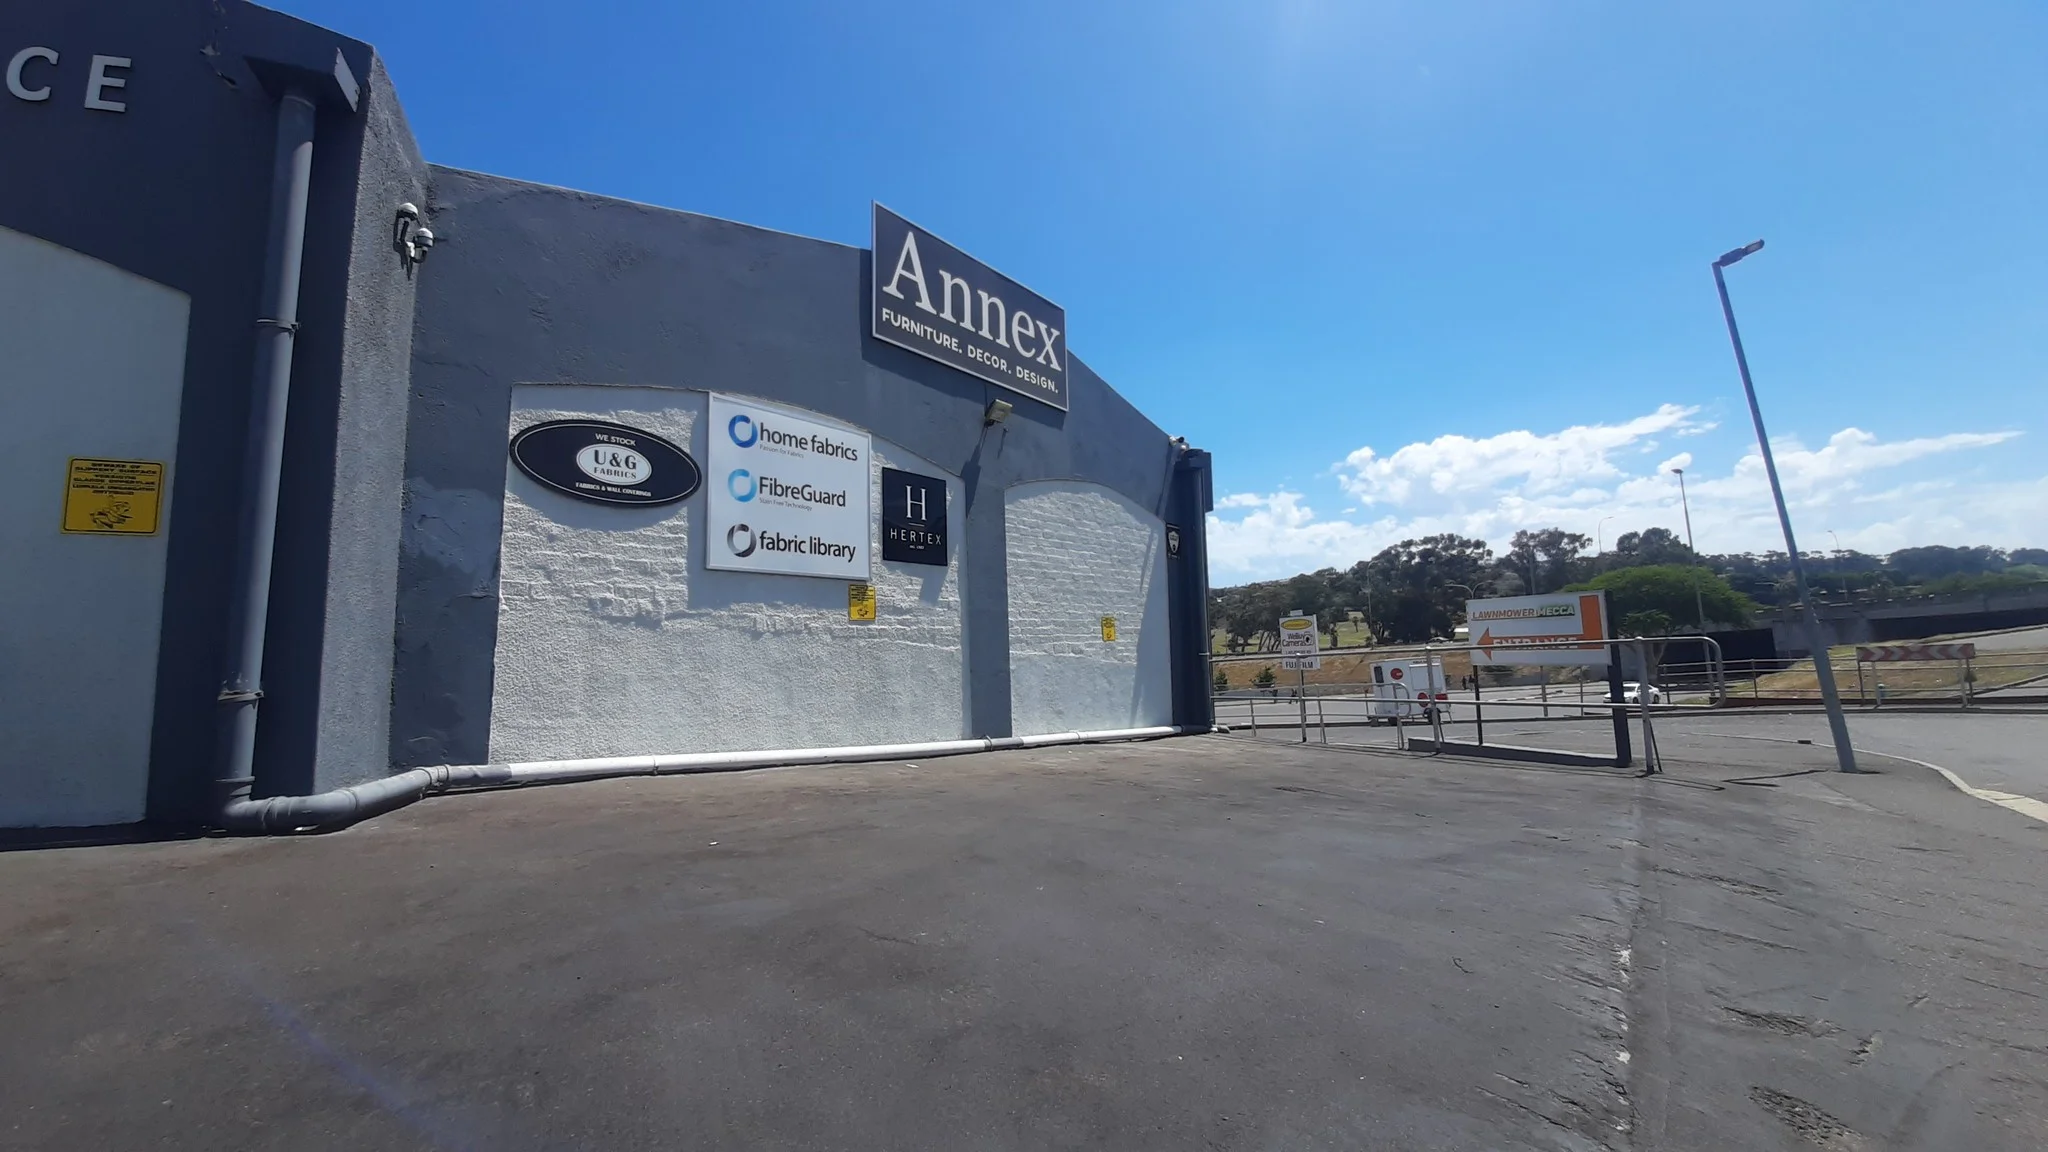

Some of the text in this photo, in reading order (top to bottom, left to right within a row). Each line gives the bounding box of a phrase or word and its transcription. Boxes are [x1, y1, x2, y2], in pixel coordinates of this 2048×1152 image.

[882, 231, 1062, 372] Annex
[882, 307, 1059, 394] FURNITURE. DECOR. DESIGN.
[595, 433, 636, 446] WE STOCK
[760, 422, 858, 461] home fabrics
[575, 482, 600, 491] FABRICS
[593, 466, 637, 479] FABRICS
[759, 476, 846, 507] FibreGuard
[905, 485, 927, 520] H
[759, 531, 856, 562] fabric library
[890, 528, 941, 545] HERTEX
